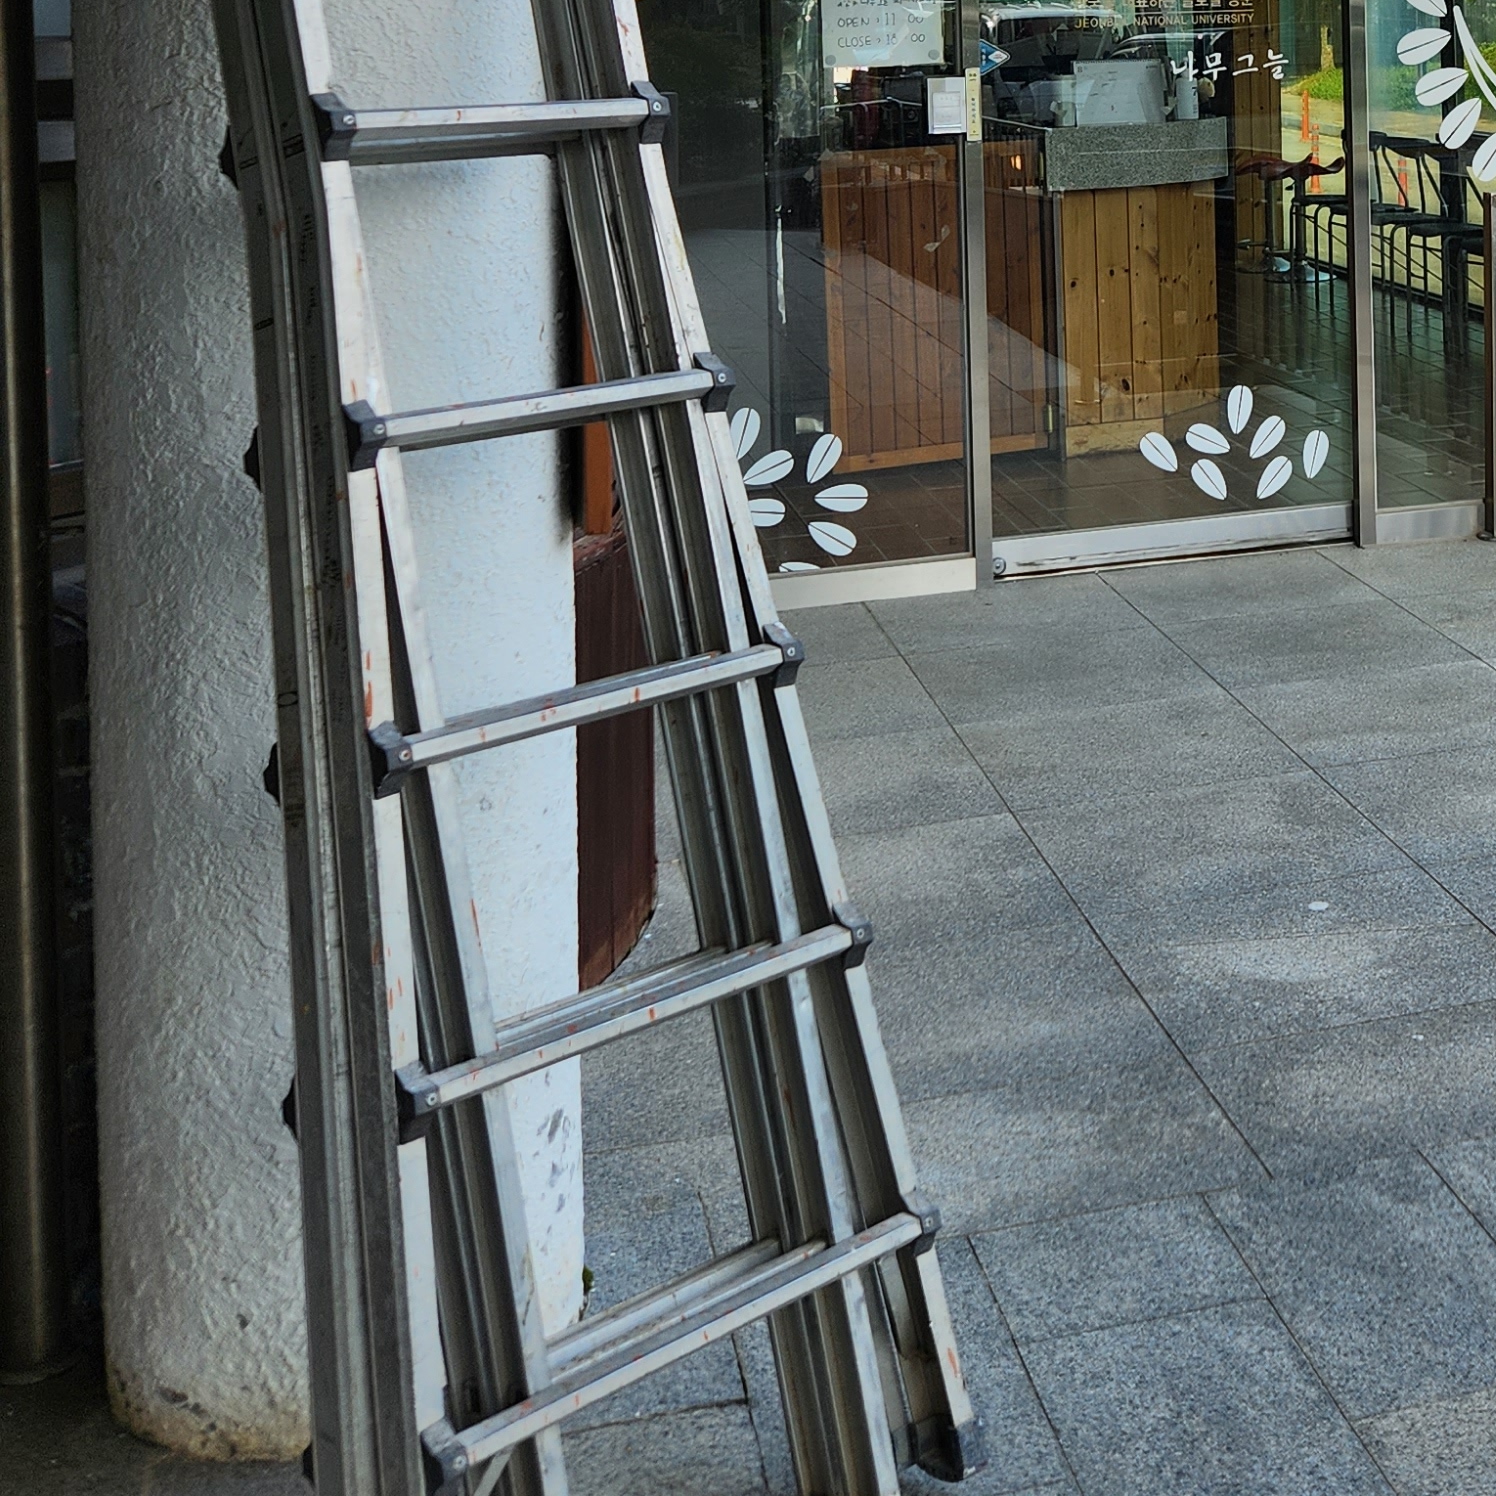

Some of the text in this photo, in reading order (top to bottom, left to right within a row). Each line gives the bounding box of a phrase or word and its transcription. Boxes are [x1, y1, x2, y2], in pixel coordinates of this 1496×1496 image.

[837, 16, 870, 28] OPEN
[1074, 12, 1255, 30] JEONB NATIONAL UNIVERSITY
[837, 35, 872, 48] CLOSE
[1170, 48, 1290, 82] 나무그늘
